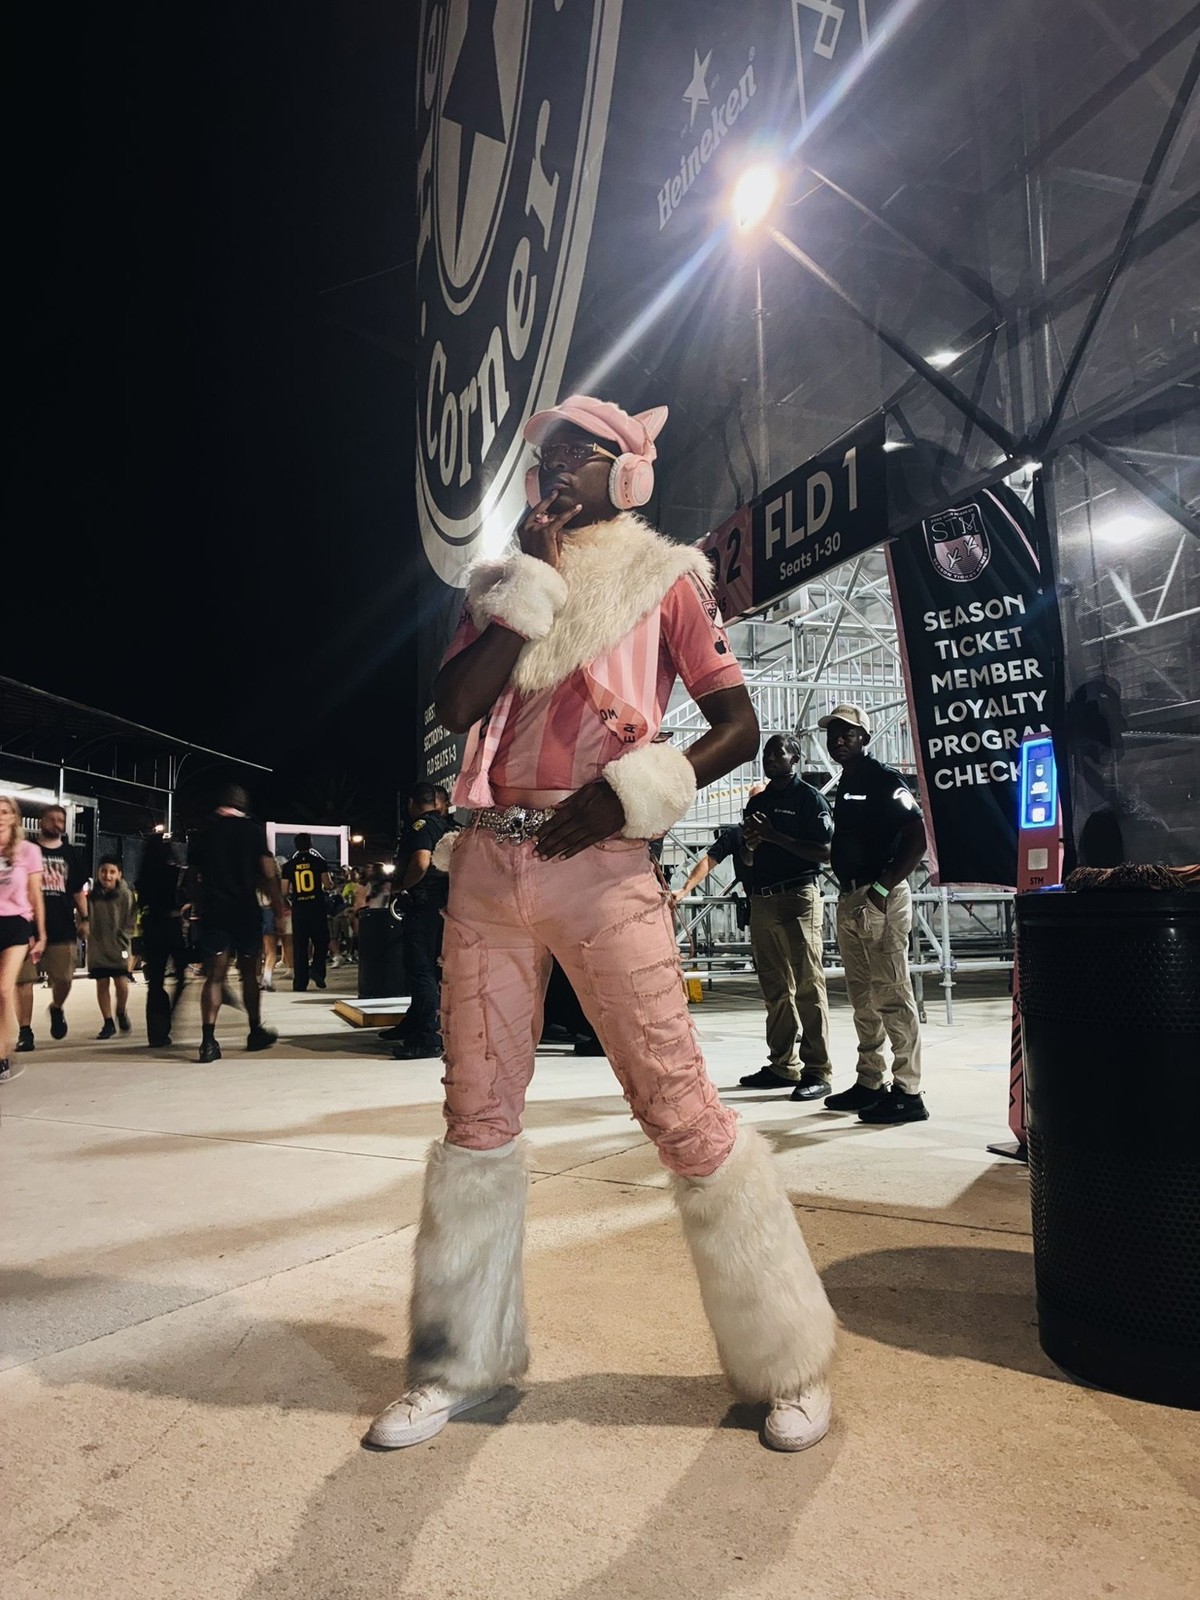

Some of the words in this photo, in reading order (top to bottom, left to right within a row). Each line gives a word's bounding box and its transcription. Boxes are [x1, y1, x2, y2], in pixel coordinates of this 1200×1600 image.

[657, 64, 757, 231] Heineken
[426, 99, 560, 488] Corner
[765, 471, 833, 560] FLD
[842, 446, 858, 511] 1
[726, 527, 742, 585] 2
[779, 552, 812, 581] Seats
[814, 531, 841, 562] 1-30
[923, 594, 1027, 632] SEASON
[934, 626, 1023, 660] TICKET
[931, 658, 1044, 694] MEMBER
[933, 690, 1047, 726] LOYALTY
[434, 748, 449, 772] SEATS
[934, 760, 1021, 790] CHECK
[294, 870, 315, 893] 10
[1029, 876, 1044, 885] STM
